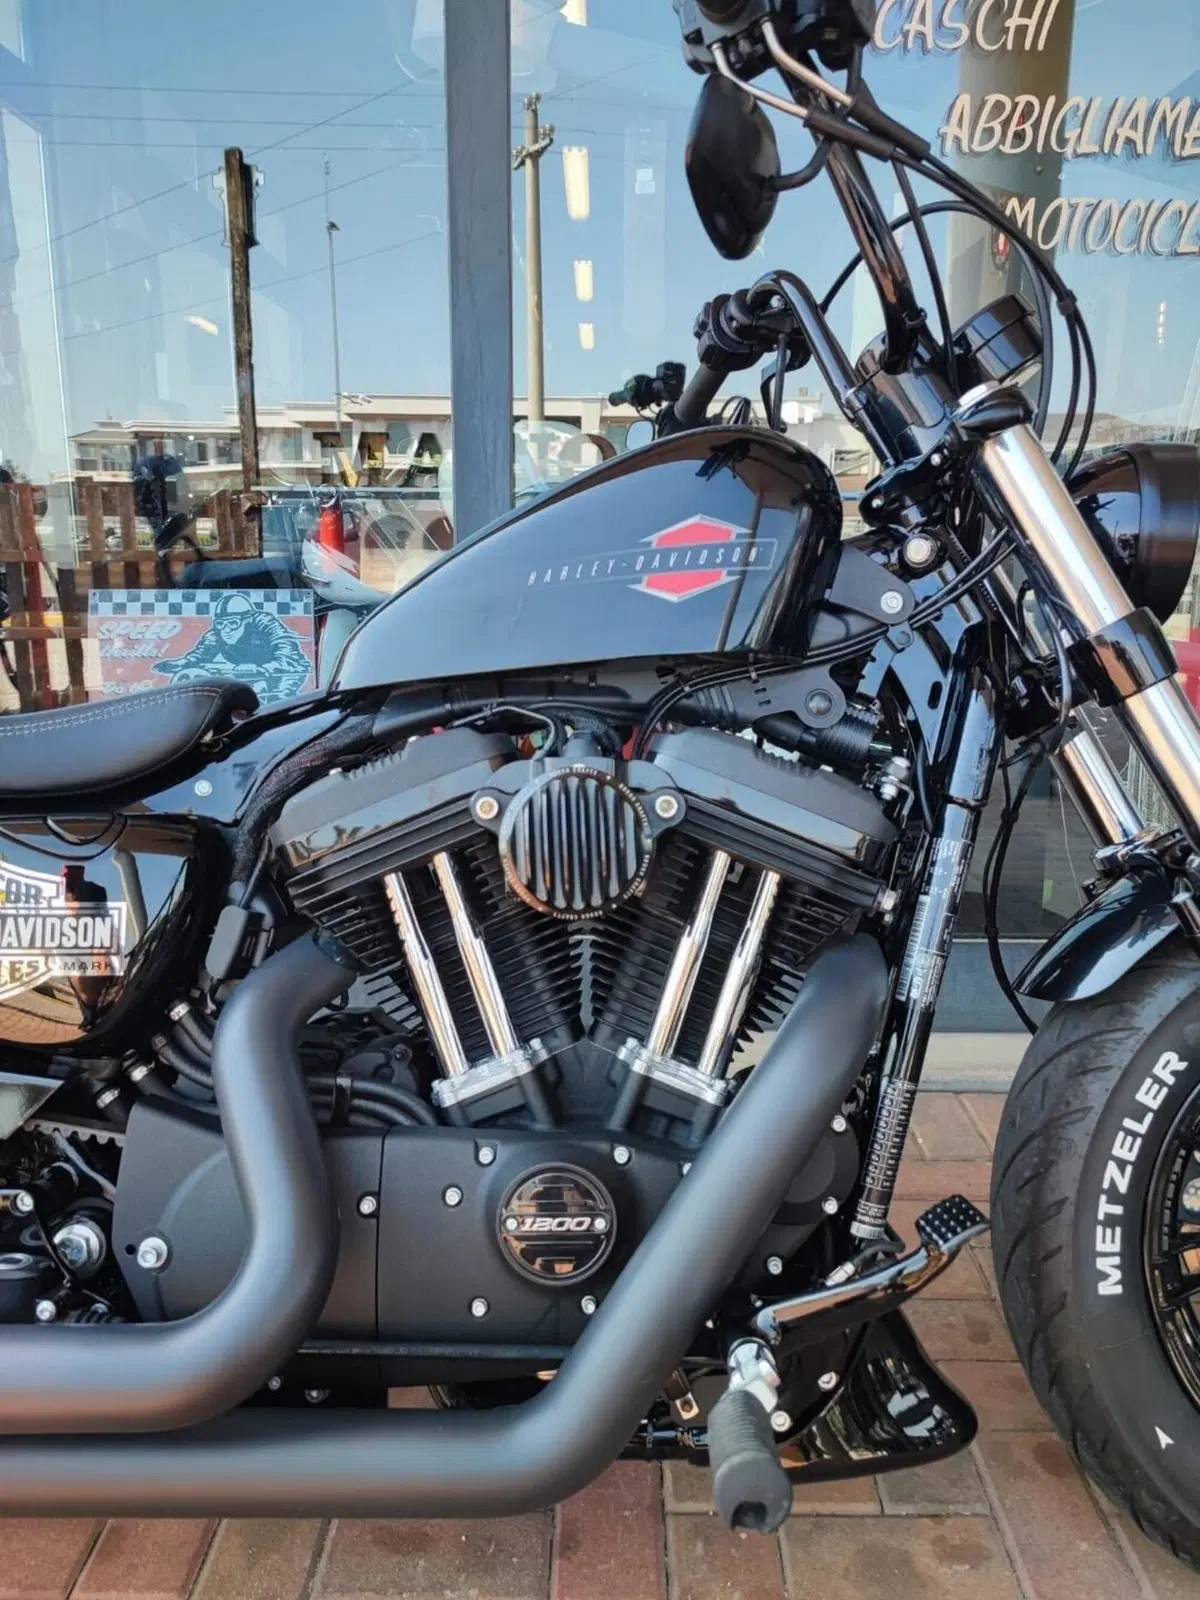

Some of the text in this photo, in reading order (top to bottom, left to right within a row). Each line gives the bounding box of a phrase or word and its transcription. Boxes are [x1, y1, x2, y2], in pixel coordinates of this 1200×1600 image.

[874, 0, 1060, 51] CASCHI
[1095, 1051, 1188, 1296] METZELER
[519, 1217, 591, 1231] 1200
